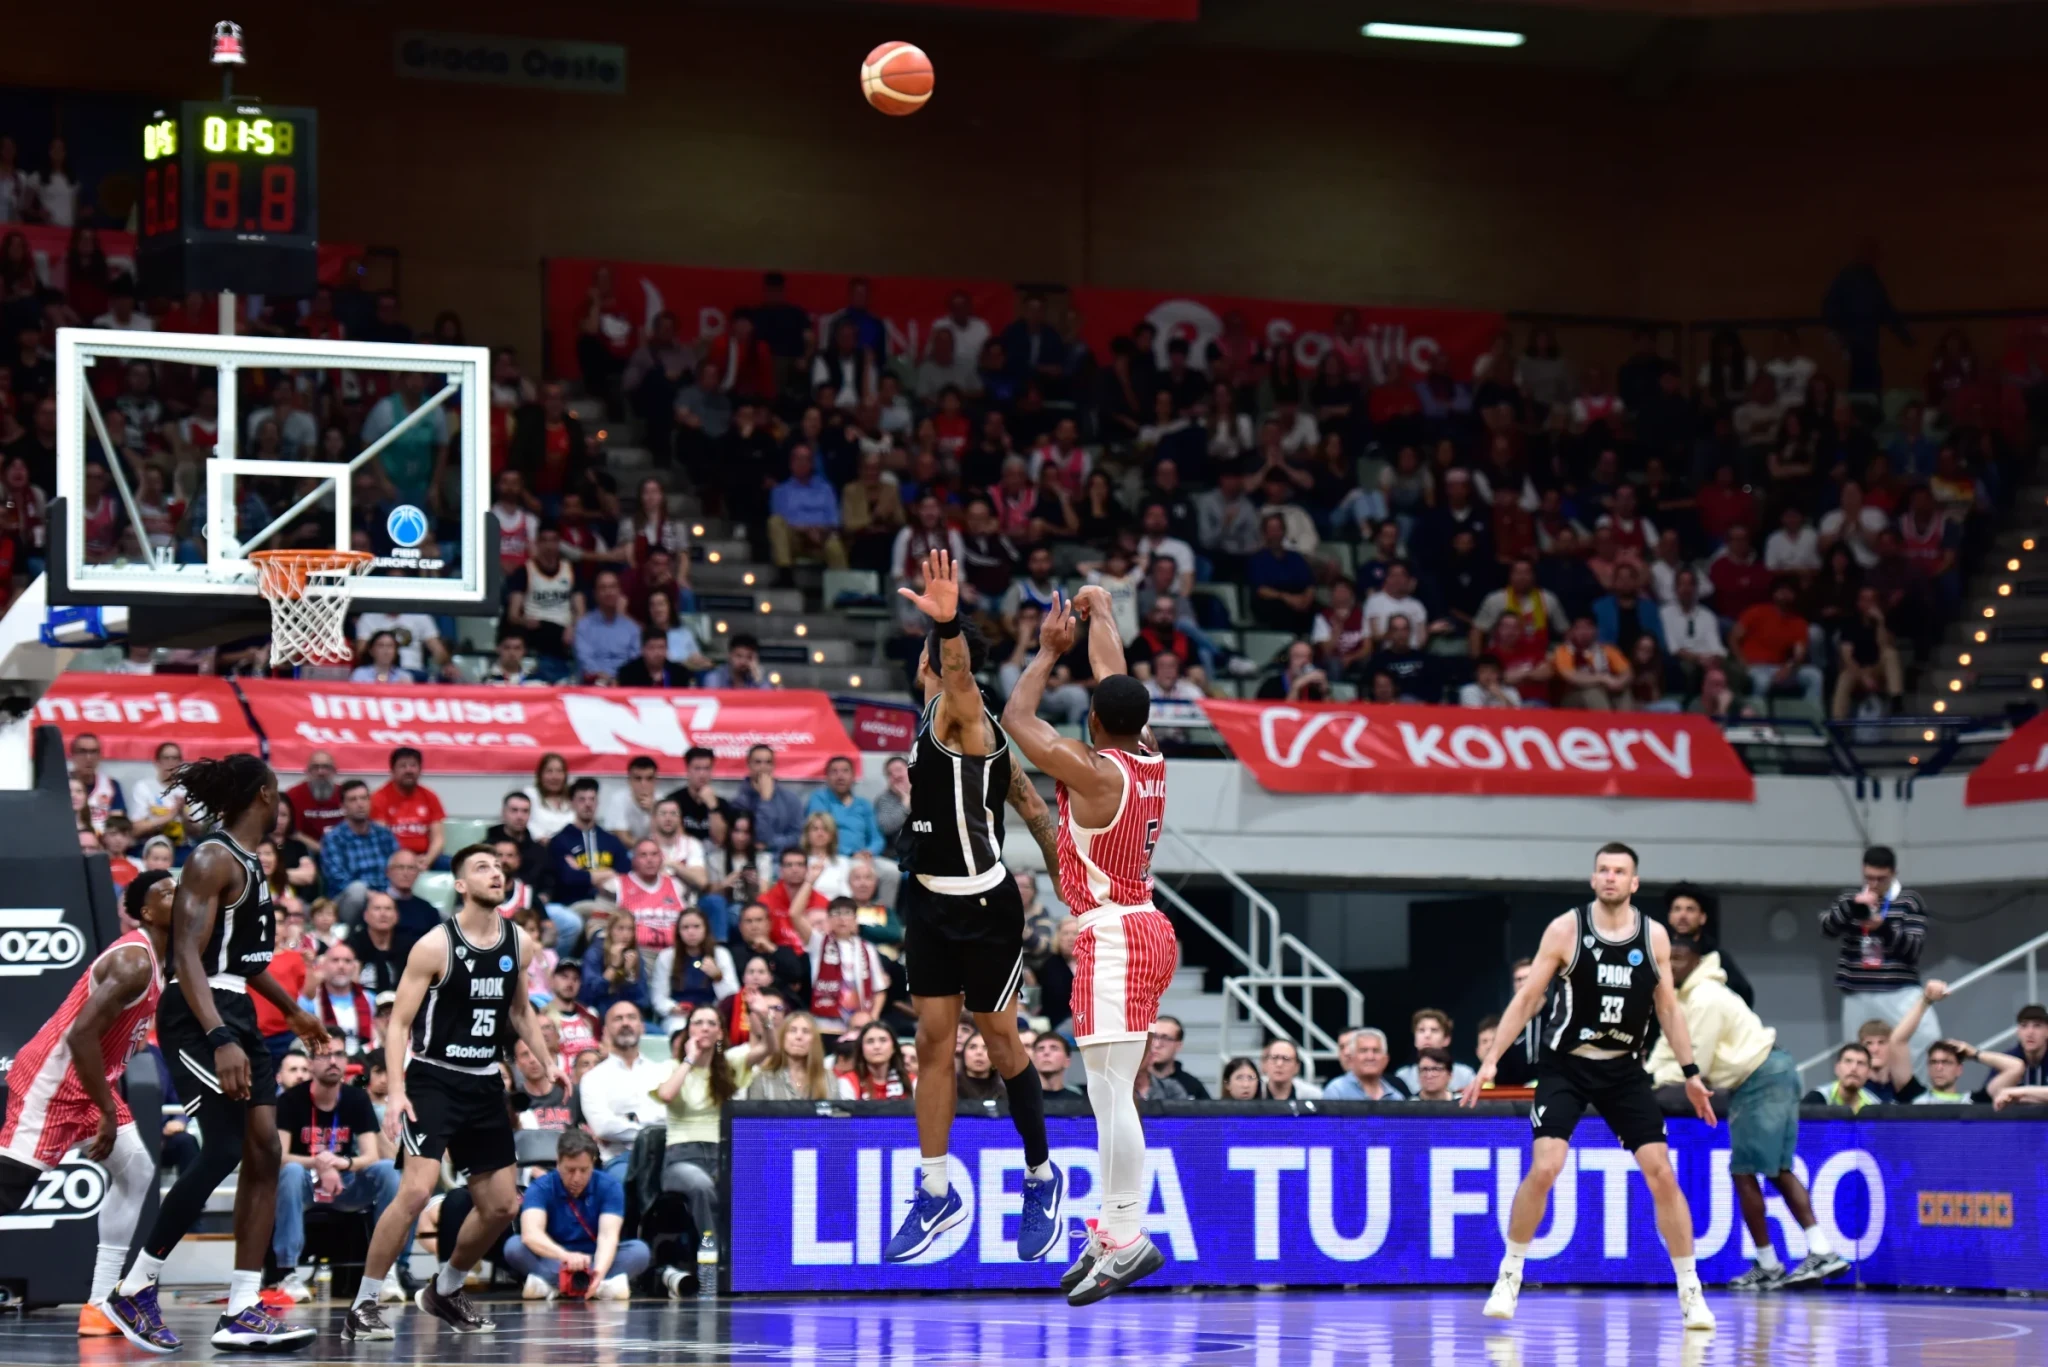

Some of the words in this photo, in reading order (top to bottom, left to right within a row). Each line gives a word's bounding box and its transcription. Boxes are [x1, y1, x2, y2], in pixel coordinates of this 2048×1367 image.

[373, 557, 418, 569] UROPE
[1396, 716, 1692, 779] konery
[470, 977, 505, 997] PAOK
[1597, 963, 1634, 986] PAOK
[470, 1008, 497, 1037] 25
[1600, 995, 1625, 1024] 33
[532, 1107, 571, 1124] CAM
[21, 1168, 104, 1210] ZO
[792, 1147, 1198, 1265] LIDERA
[1228, 1147, 1391, 1261] TU
[1430, 1147, 1886, 1263] FUTURO
